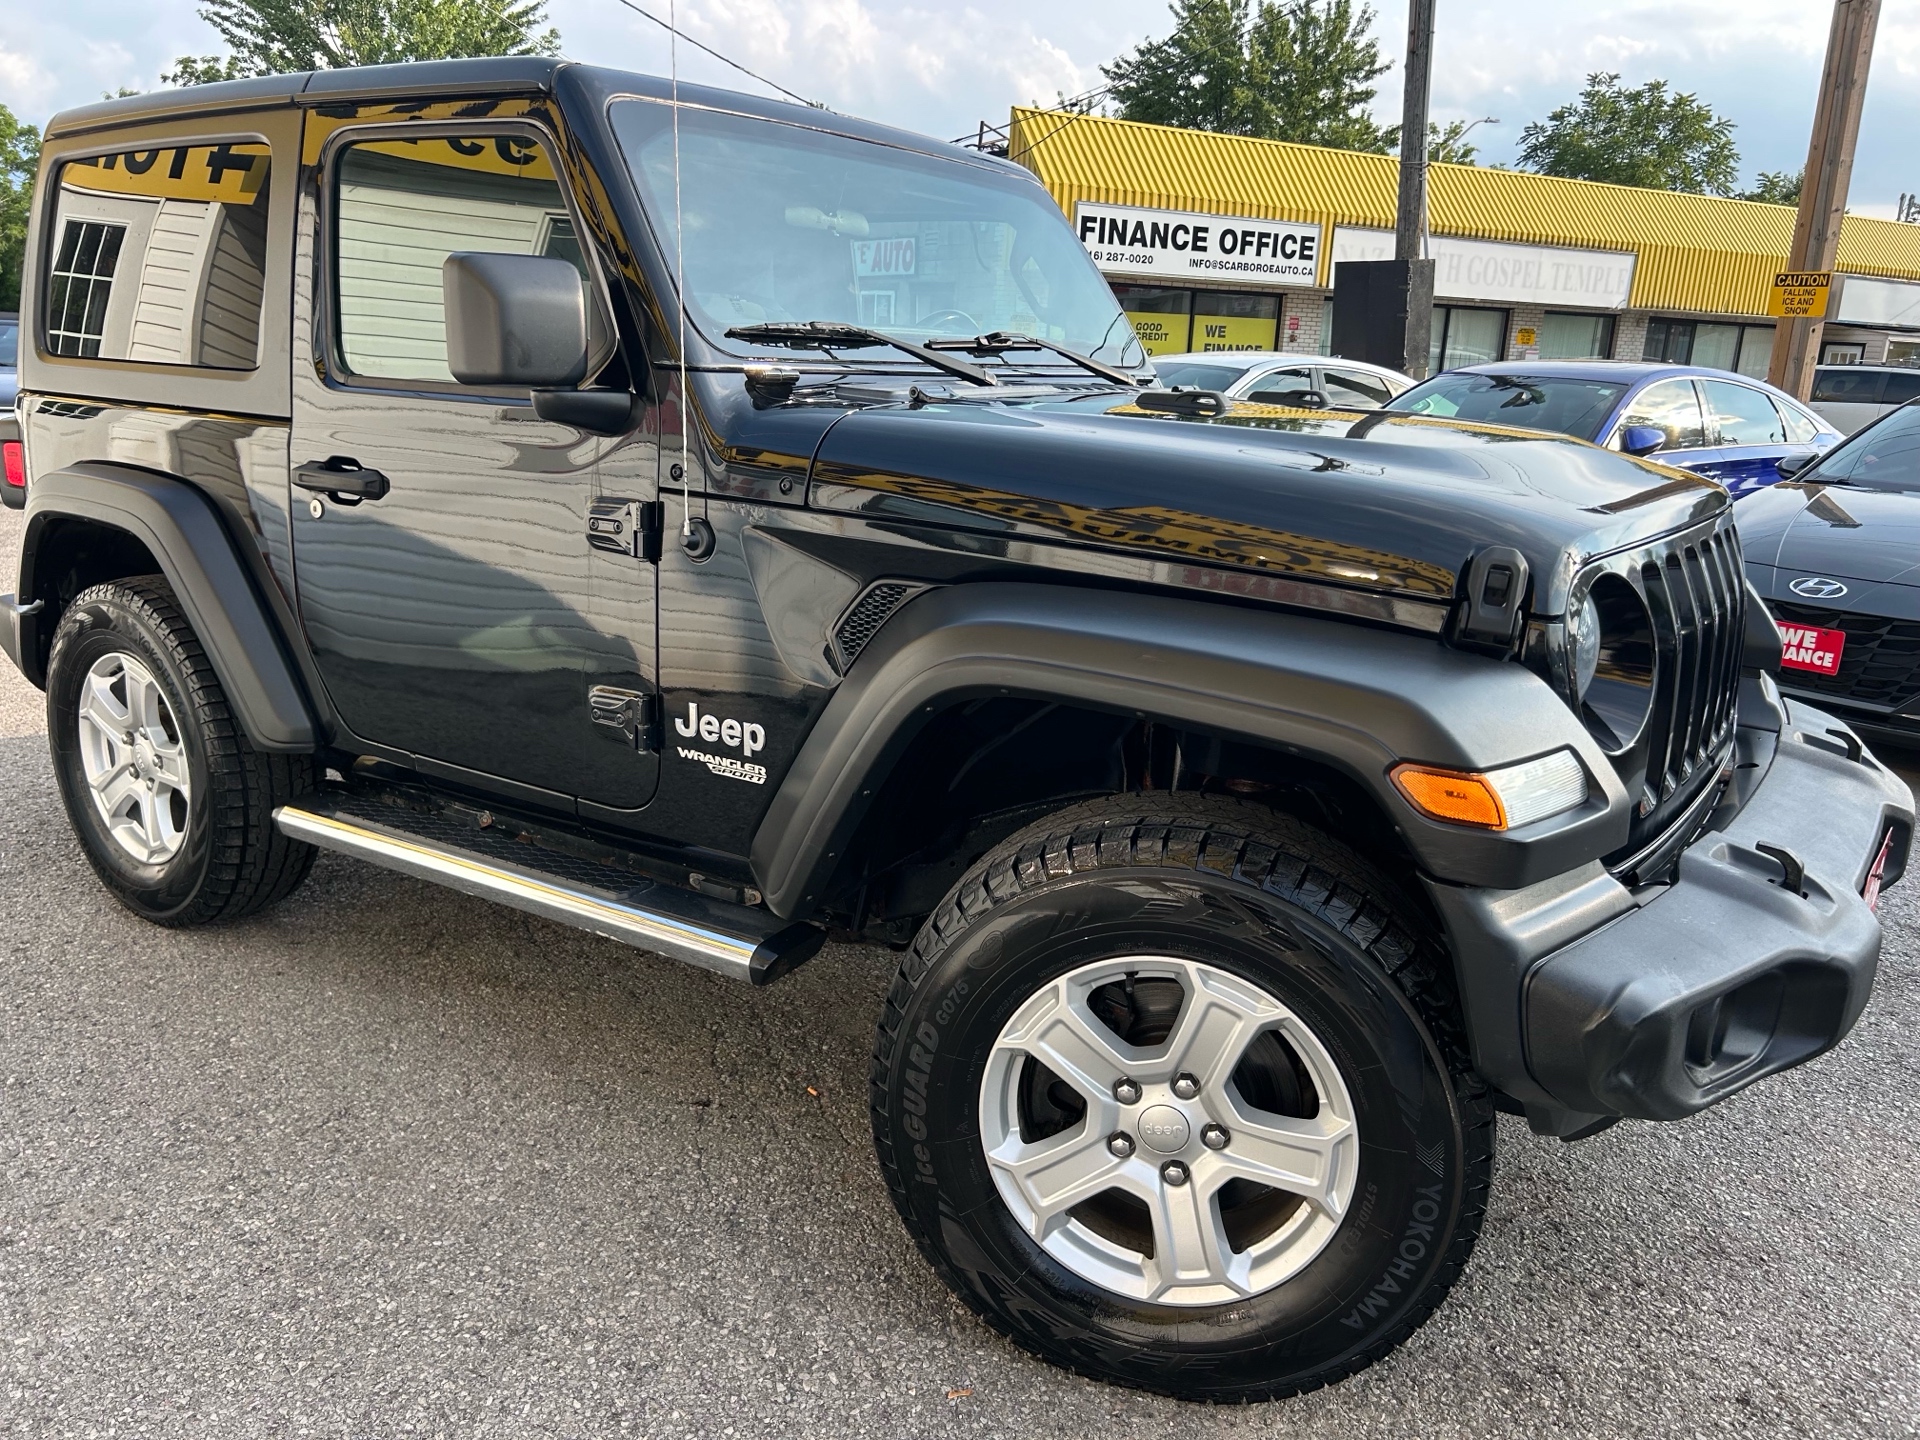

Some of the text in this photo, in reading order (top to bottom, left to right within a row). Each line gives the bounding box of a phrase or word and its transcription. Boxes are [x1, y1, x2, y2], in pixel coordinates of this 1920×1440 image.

[1080, 215, 1316, 261] FINANCE OFFICE
[871, 240, 914, 273] AUTO
[1106, 252, 1154, 264] 287-0020
[1189, 258, 1313, 276] INFO@SCARBOROEAUTO.CA
[1467, 254, 1546, 290] GOSPEL
[1552, 262, 1629, 295] TEMPLE
[1777, 274, 1828, 286] CAUTION
[1782, 297, 1815, 306] ICE AND
[1783, 288, 1817, 297] FALLING
[1784, 306, 1810, 315] SNOW
[1135, 322, 1163, 332] GOOD
[1205, 324, 1227, 338] WE
[1137, 332, 1169, 342] CREDIT
[1779, 626, 1818, 649] WE
[1782, 645, 1834, 668] ANCE
[675, 702, 766, 757] Jeep
[677, 746, 767, 776] WRANGLER
[711, 766, 766, 782] SPORT
[935, 979, 969, 1026] G075
[1339, 1183, 1443, 1331] YOKOHAMA
